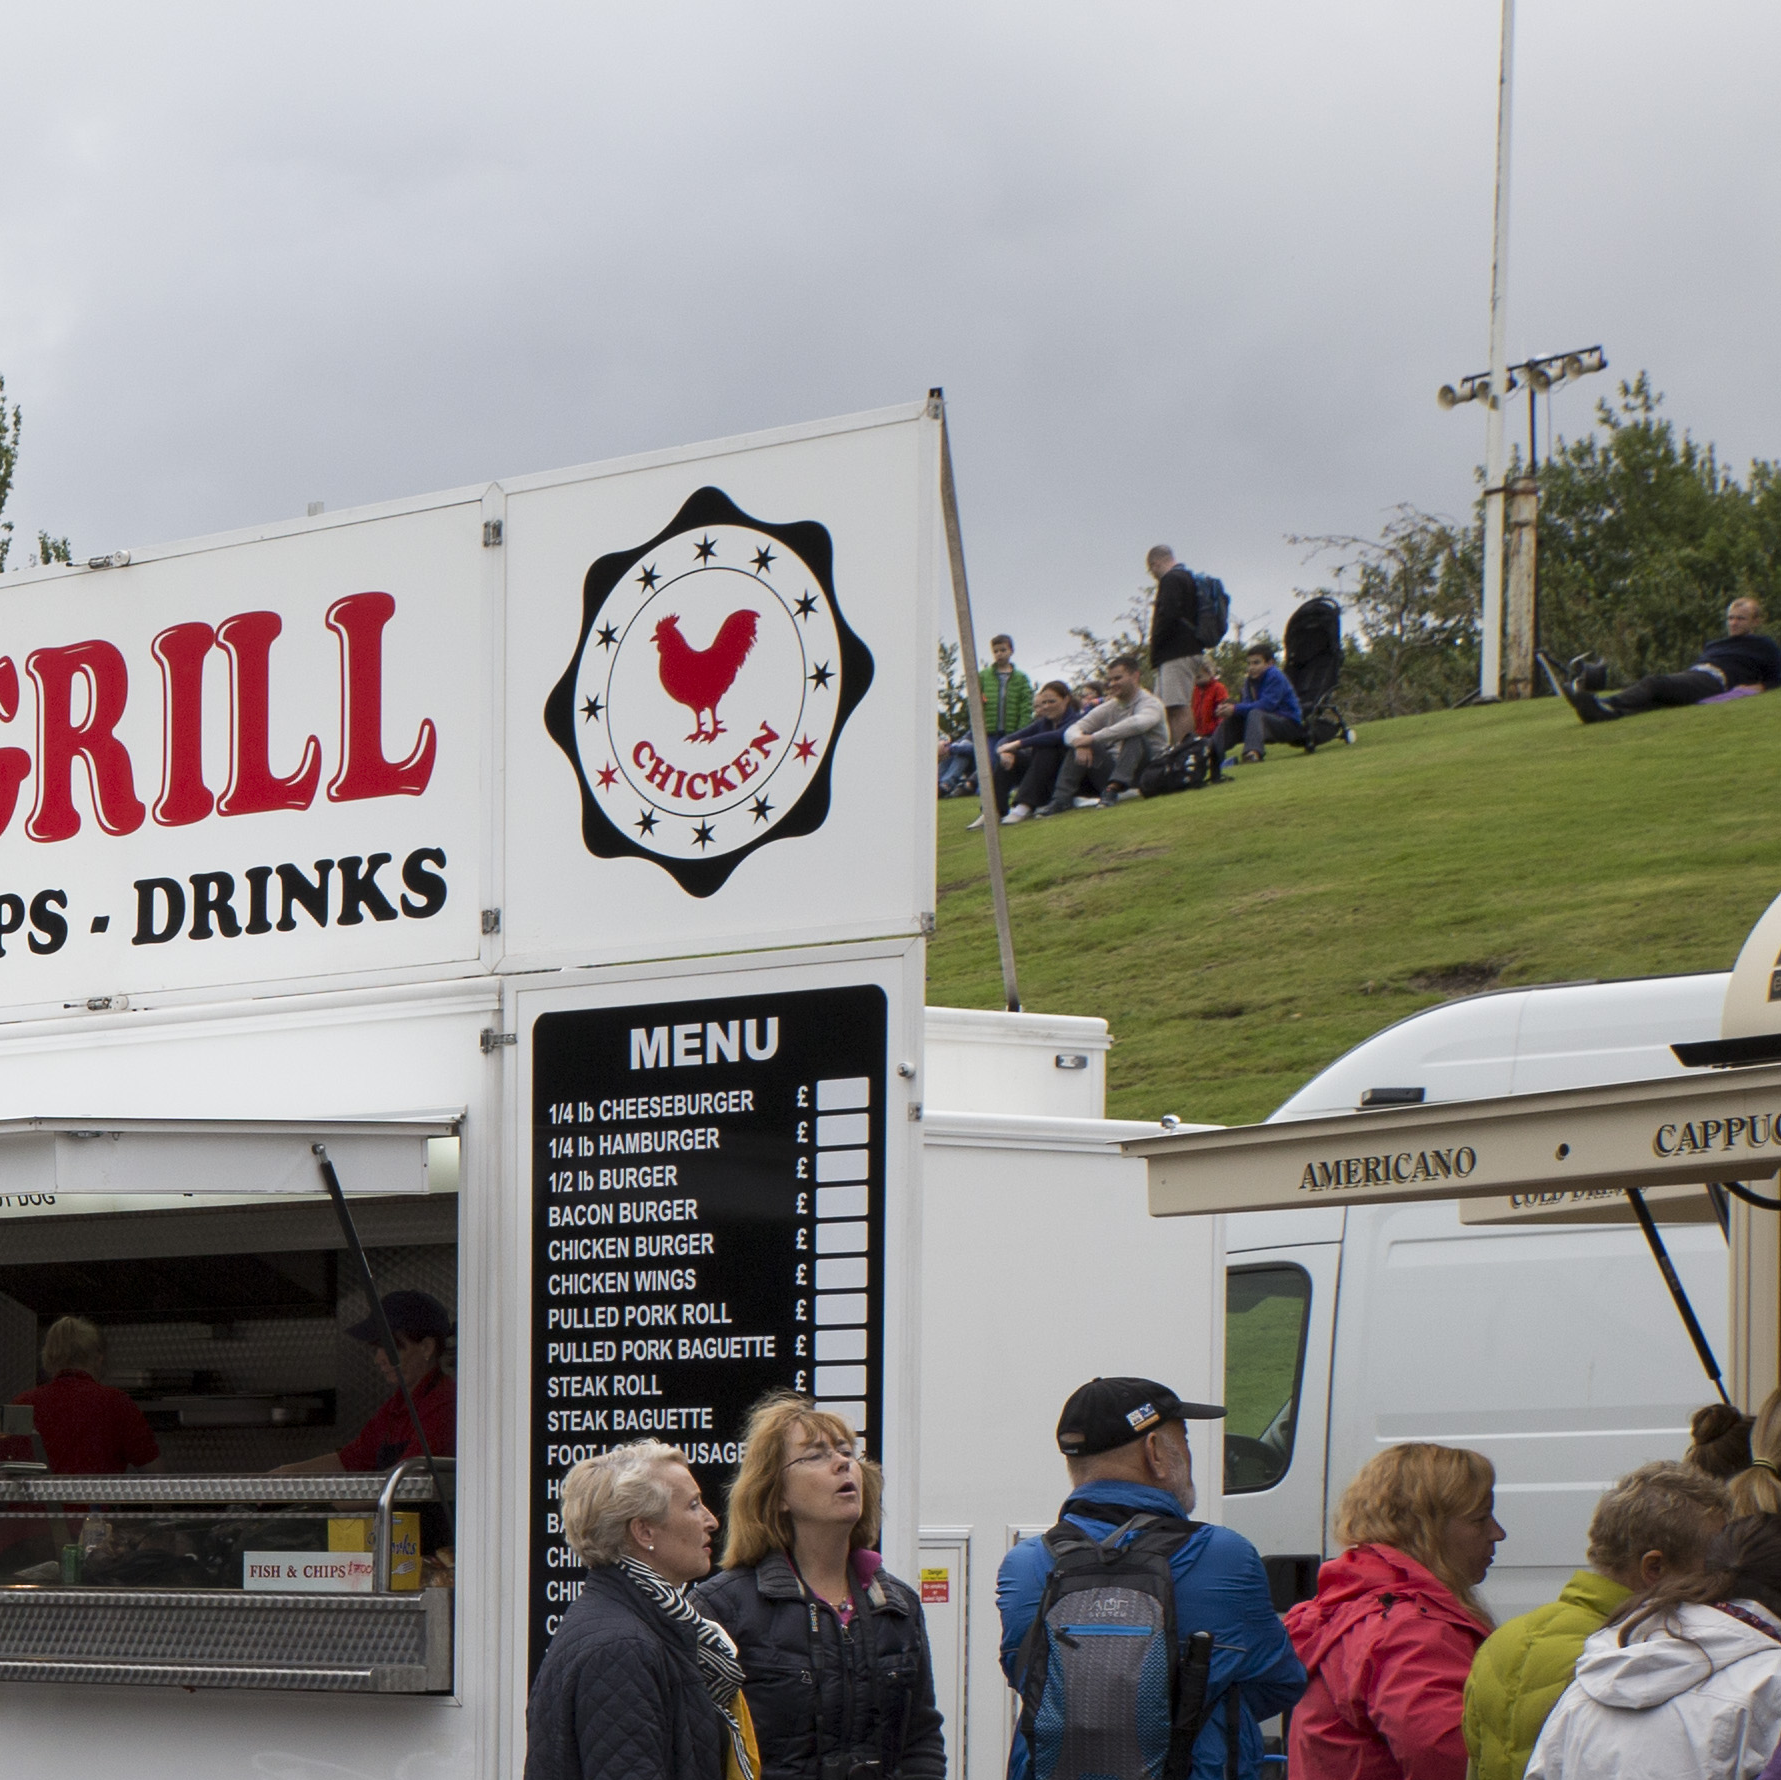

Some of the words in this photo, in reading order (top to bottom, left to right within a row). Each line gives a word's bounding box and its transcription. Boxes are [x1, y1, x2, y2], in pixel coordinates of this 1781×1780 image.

[629, 721, 780, 801] CHICKEN
[133, 847, 447, 946] DRINKS
[630, 1017, 779, 1070] MENU
[549, 1103, 573, 1124] 1/4
[578, 1100, 594, 1122] lb
[599, 1090, 754, 1121] CHEESEBURGER
[549, 1138, 573, 1159] 1/4
[578, 1135, 594, 1156] lb
[599, 1127, 720, 1155] HAMBURGER
[549, 1172, 573, 1193] 1/2
[578, 1169, 594, 1191] lb
[599, 1165, 678, 1190] BURGER
[1298, 1146, 1476, 1190] AMERICANO
[549, 1203, 613, 1227] BACON
[619, 1199, 698, 1224] BURGER
[549, 1237, 629, 1261] CHICKEN
[635, 1233, 715, 1258] BURGER
[548, 1272, 629, 1295] CHICKEN
[634, 1268, 697, 1293] WINGS
[548, 1307, 619, 1329] PULLED
[624, 1304, 678, 1327] PORK
[682, 1303, 733, 1325] ROLL
[548, 1341, 617, 1363] PULLED
[621, 1338, 673, 1361] PORK
[678, 1335, 776, 1359] BAGUETTE
[547, 1376, 608, 1398] STEAK
[613, 1374, 663, 1396] ROLL
[547, 1410, 608, 1432] STEAK
[613, 1407, 713, 1431] BAGUETTE
[250, 1565, 280, 1578] FISH
[287, 1565, 297, 1578] &
[303, 1565, 346, 1578] CHIPS
